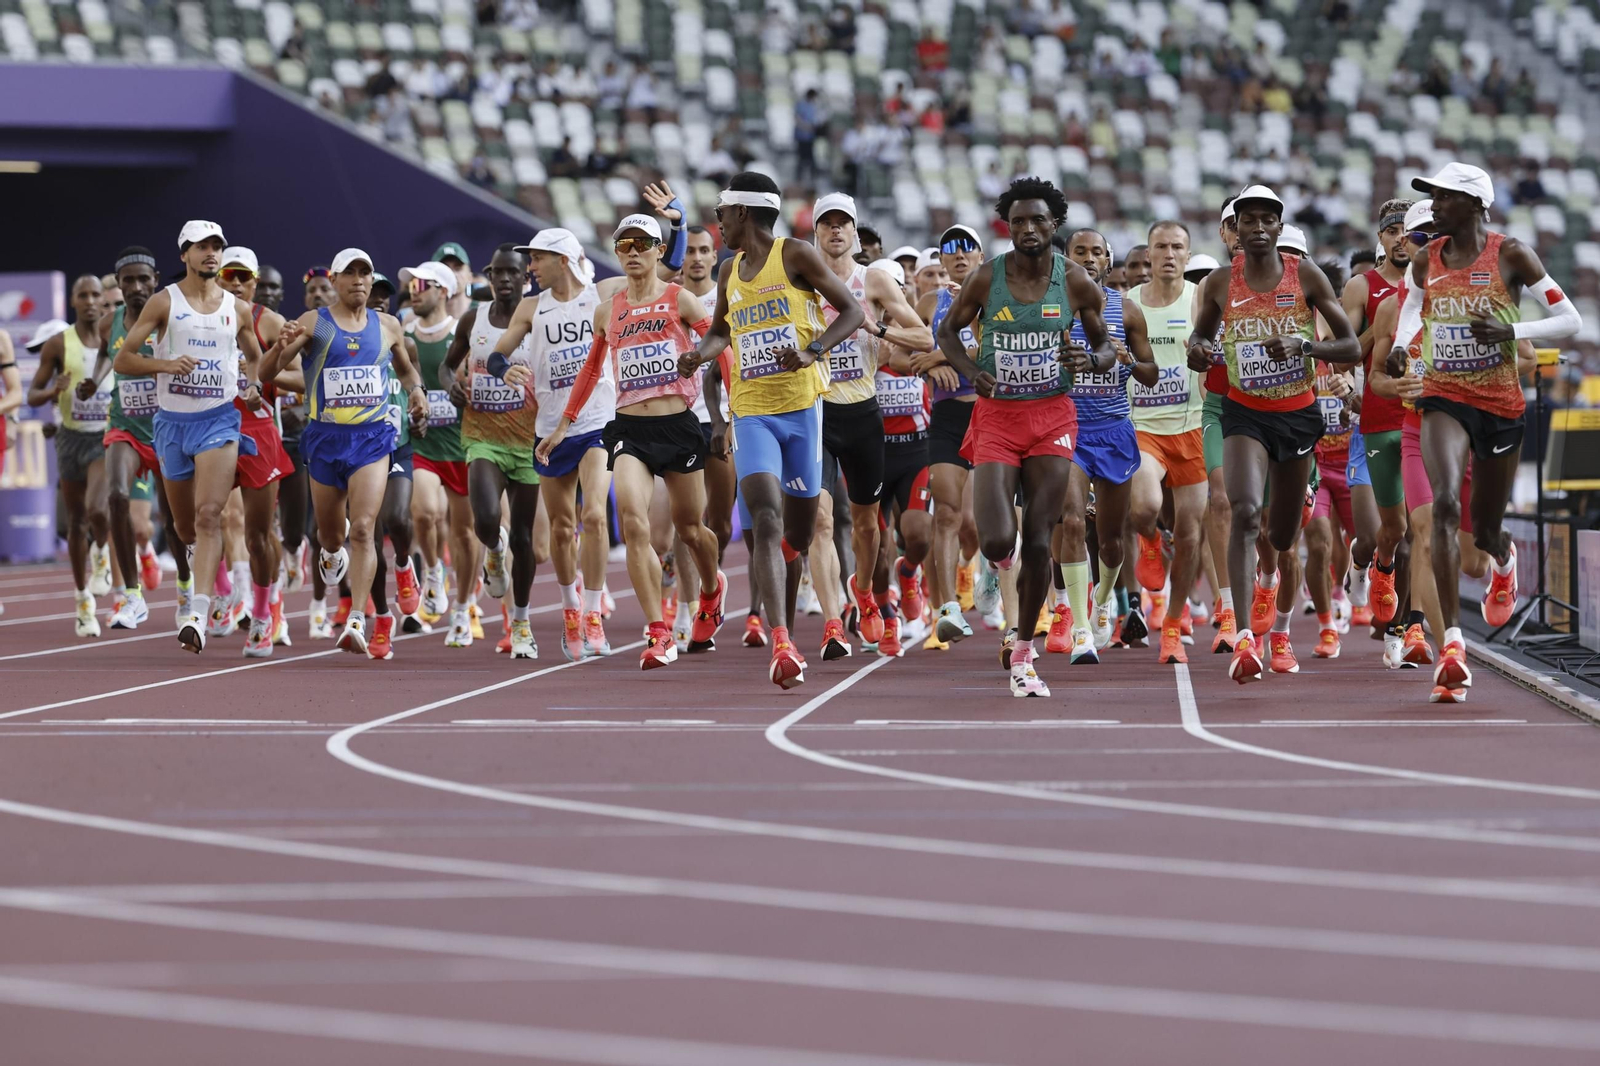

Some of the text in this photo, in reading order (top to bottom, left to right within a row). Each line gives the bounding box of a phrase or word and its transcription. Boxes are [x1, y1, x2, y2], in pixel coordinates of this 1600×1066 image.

[731, 296, 790, 330] SWEDEN
[1431, 296, 1494, 317] KENYA
[545, 319, 594, 345] USA
[618, 319, 666, 339] JAPAN
[1233, 316, 1298, 337] KENYA
[188, 338, 217, 348] ITALIA
[749, 326, 792, 346] TDK
[993, 331, 1061, 350] ETHIOPIA
[630, 342, 671, 359] TDK
[1013, 350, 1055, 366] TDK
[1436, 343, 1498, 358] NGETICH
[196, 360, 222, 371] DK
[621, 358, 674, 379] KONDO
[1000, 364, 1057, 383] TAKELE
[1242, 355, 1301, 376] KIPKOECH
[173, 374, 222, 386] AOUANI
[339, 368, 376, 380] TDK
[335, 383, 374, 396] JAMI
[884, 379, 918, 390] TDK
[474, 389, 521, 401] BIZOZA
[876, 392, 921, 405] ERECEDA
[884, 434, 914, 443] PERU
